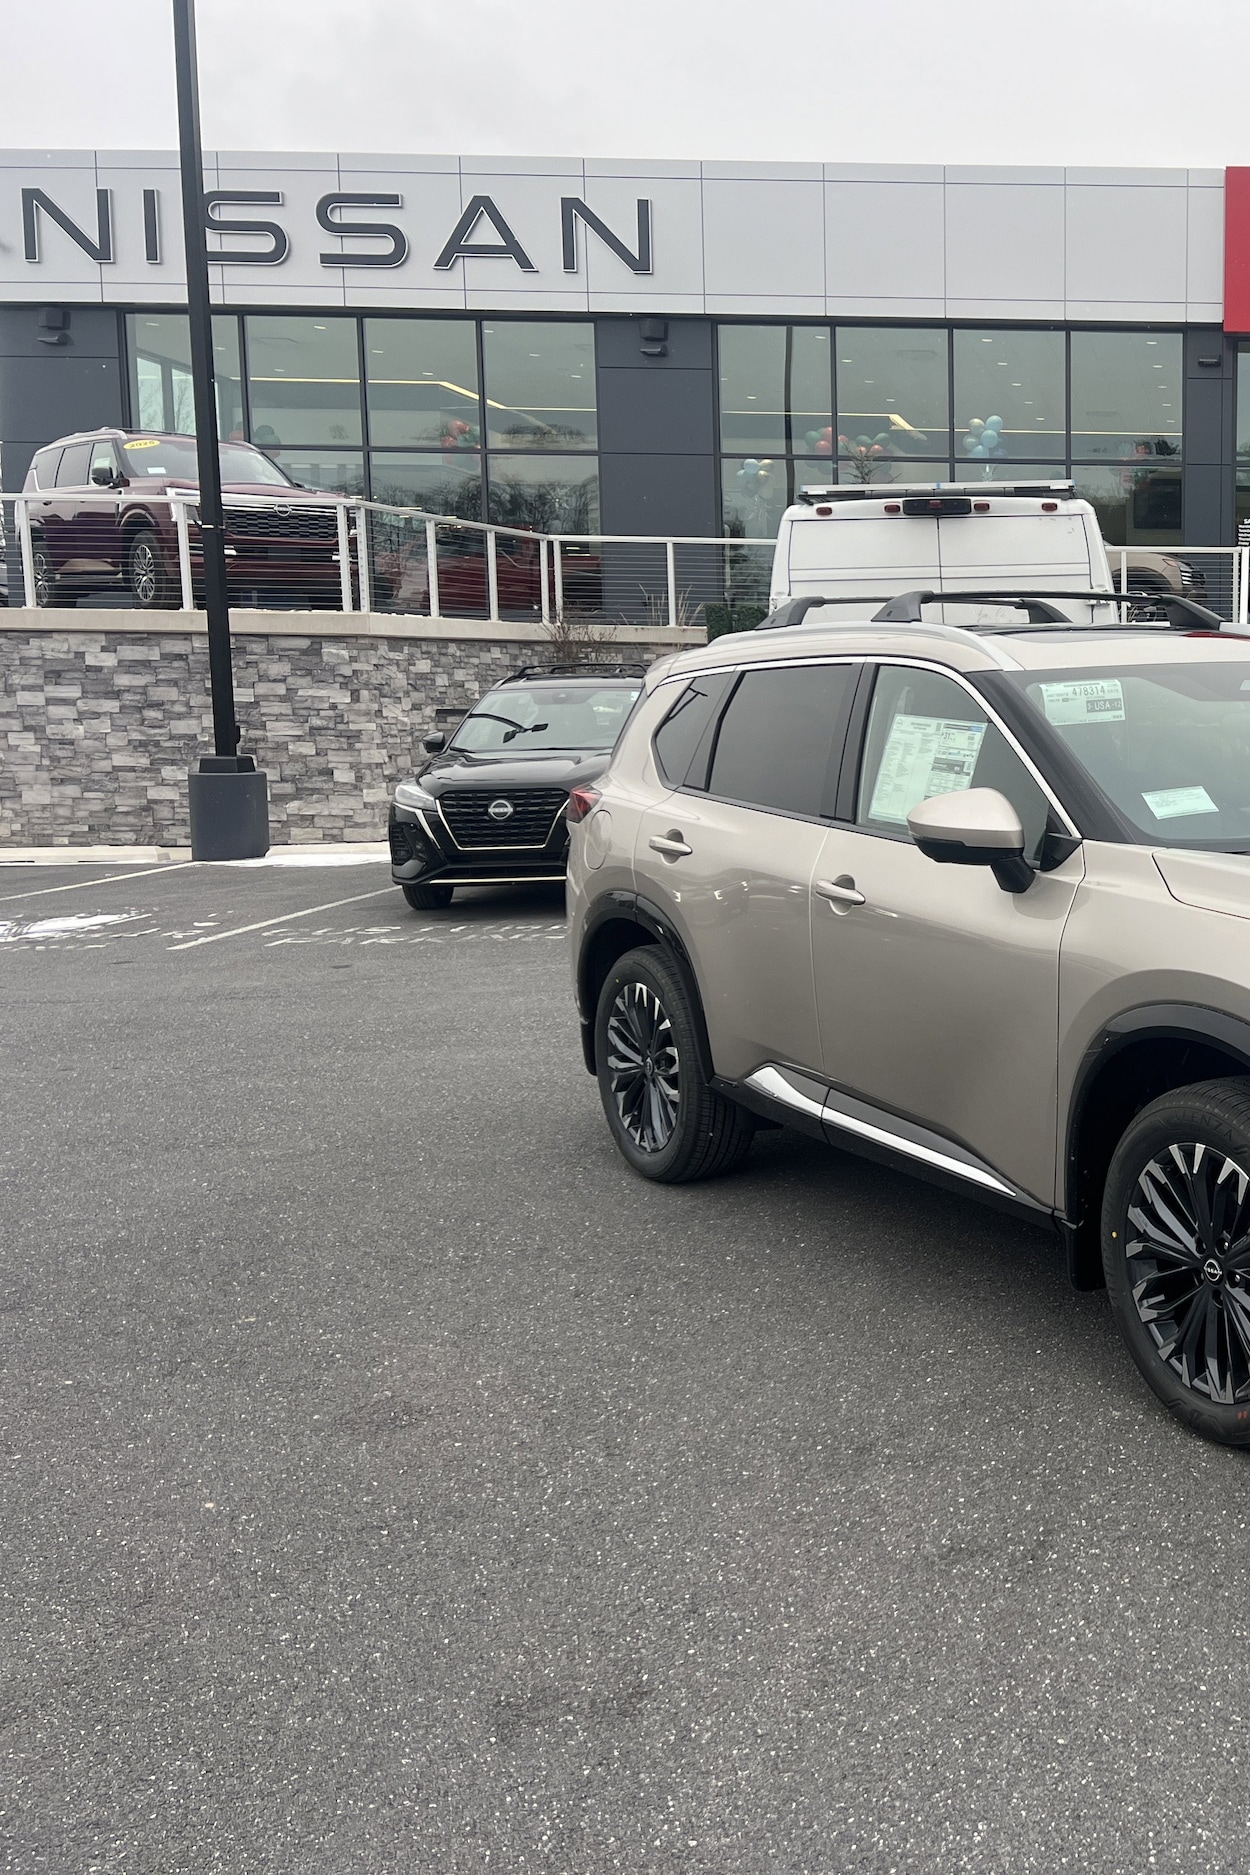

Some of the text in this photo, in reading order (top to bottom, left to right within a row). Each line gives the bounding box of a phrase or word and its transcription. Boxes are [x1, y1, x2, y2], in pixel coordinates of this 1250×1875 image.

[21, 187, 653, 274] NISSAN
[1072, 685, 1106, 697] 478314
[1094, 700, 1111, 710] USA
